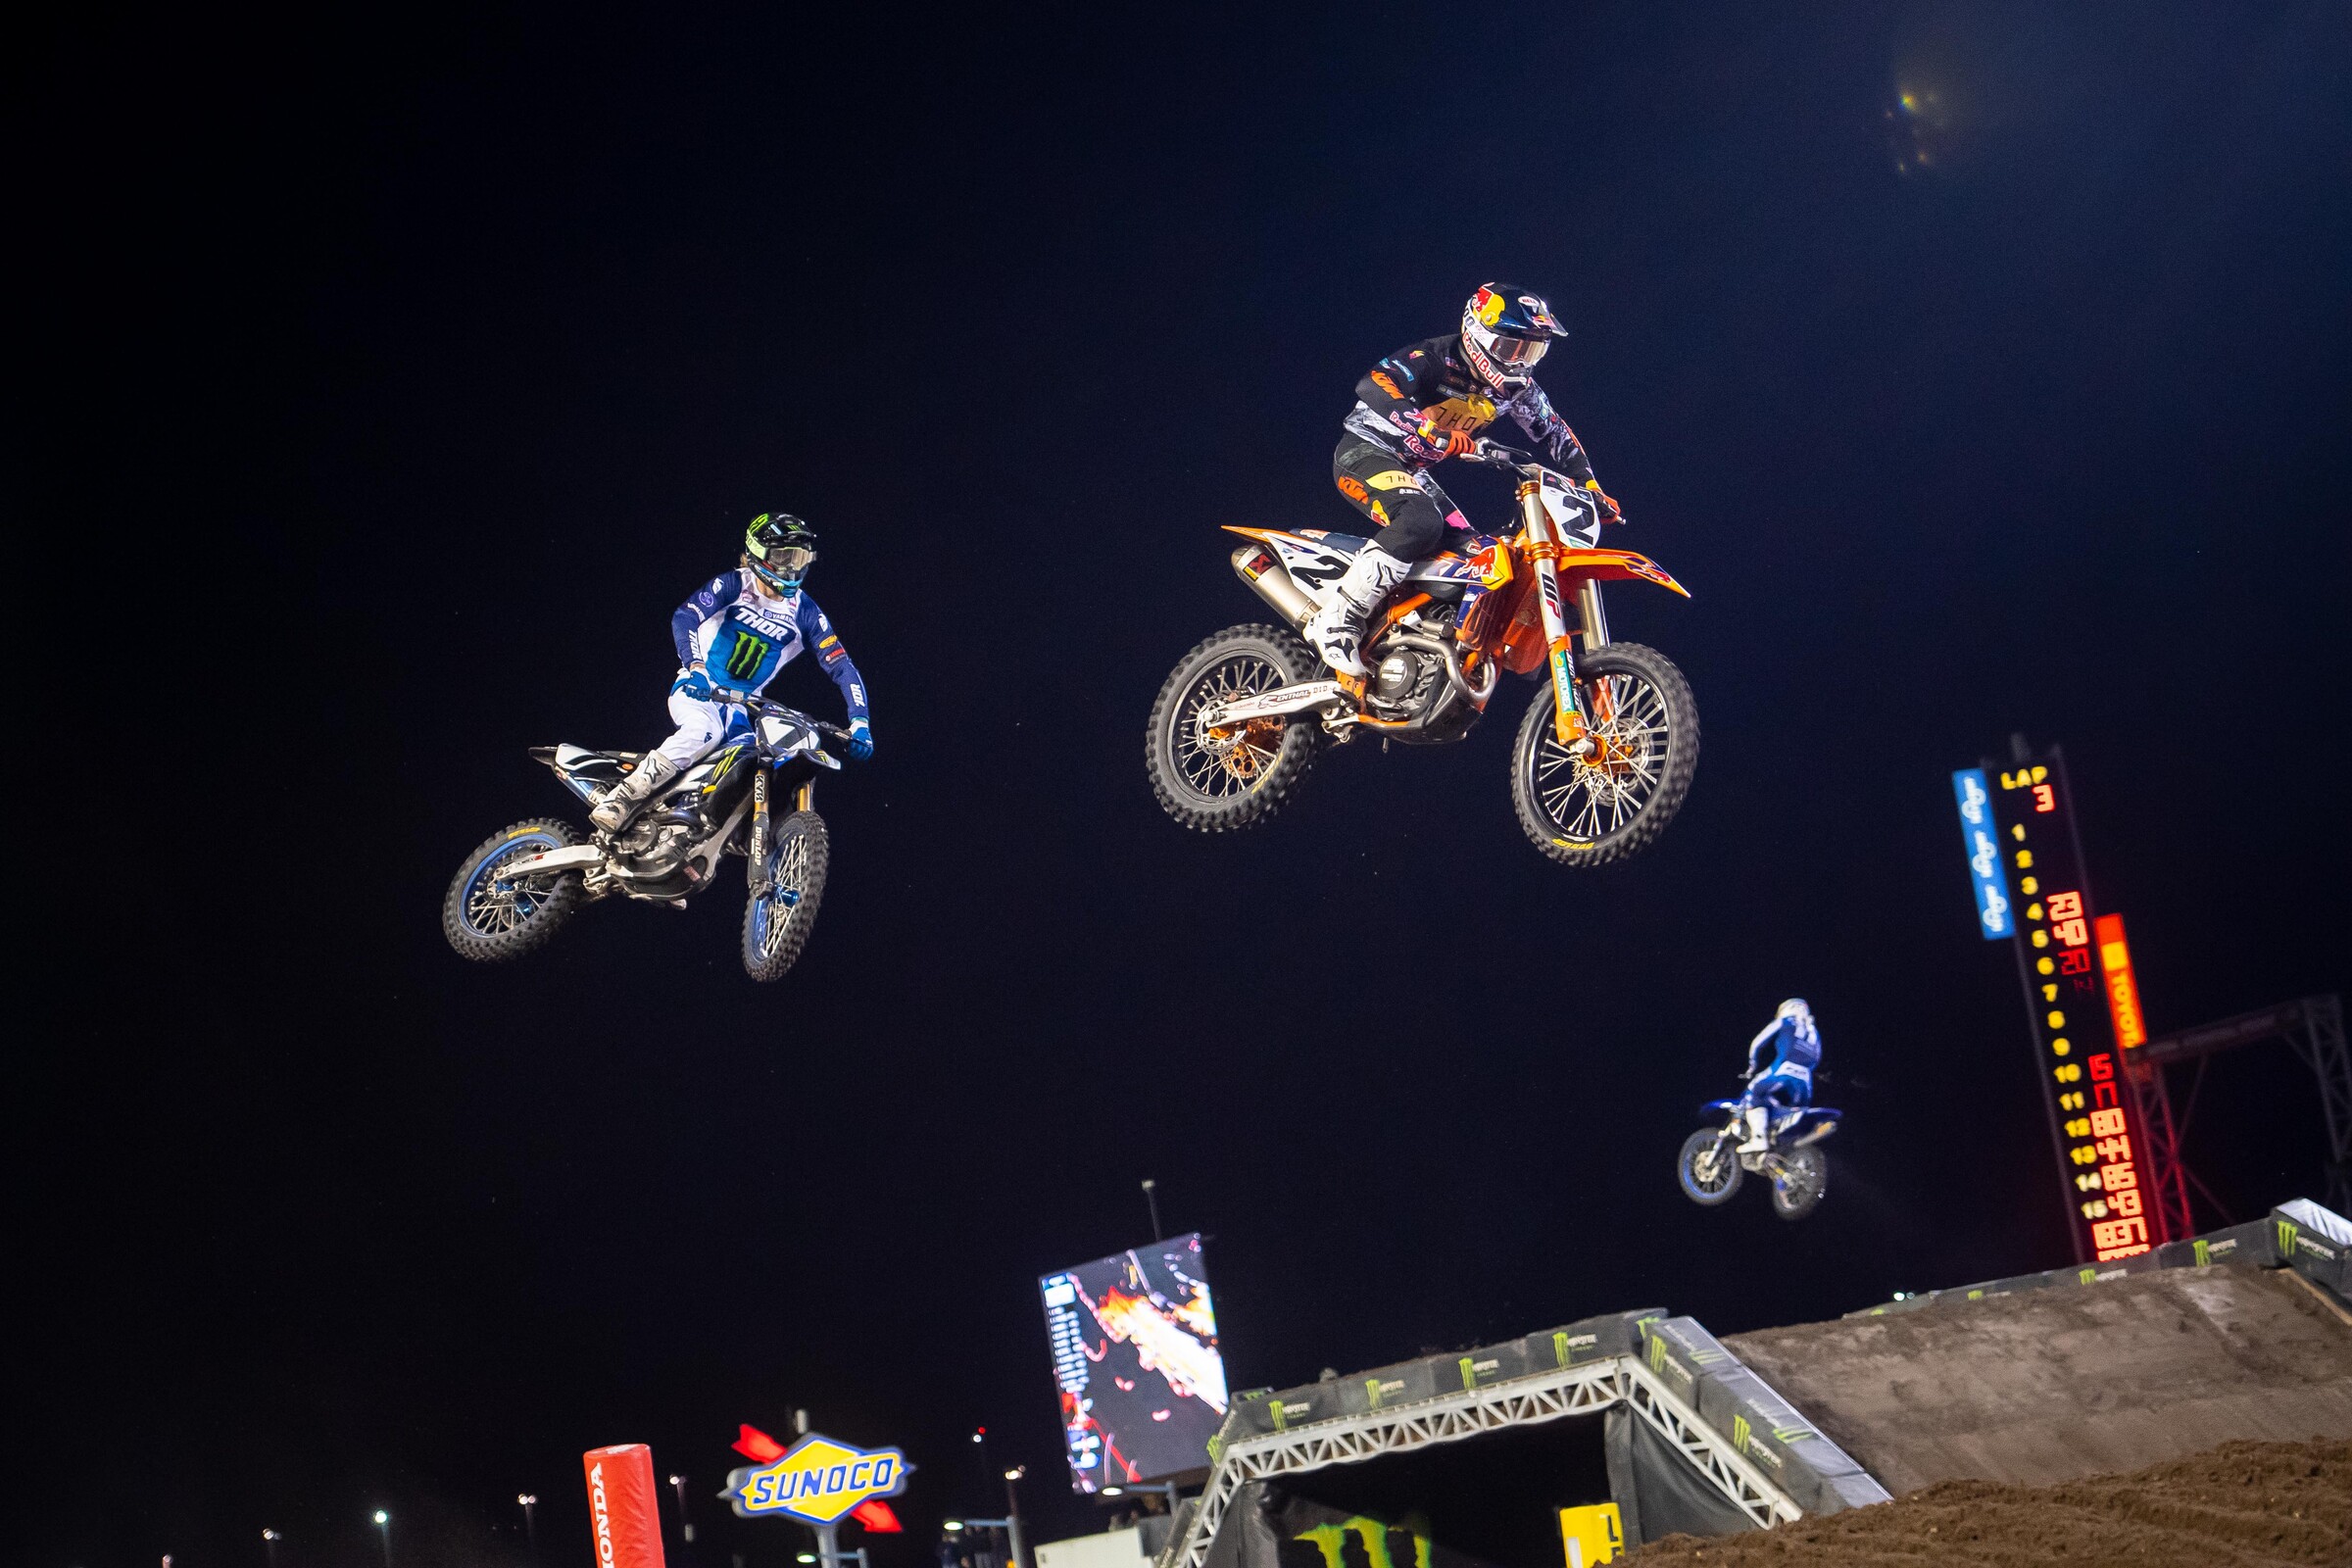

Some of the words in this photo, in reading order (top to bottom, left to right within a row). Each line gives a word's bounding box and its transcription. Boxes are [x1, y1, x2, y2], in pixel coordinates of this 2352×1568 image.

[1478, 359, 1505, 388] Bull
[1561, 494, 1596, 546] 2
[1290, 555, 1351, 591] 2
[735, 607, 788, 642] THOR
[1555, 665, 1572, 711] MOTOREX
[2000, 765, 2048, 790] LAP
[2032, 784, 2054, 812] 3
[754, 825, 762, 866] DUNLOP
[2011, 823, 2026, 842] 1
[2027, 903, 2043, 920] 4
[2041, 983, 2058, 1002] 7
[2059, 1091, 2085, 1110] 11
[2075, 1172, 2103, 1192] 14
[2081, 1200, 2108, 1219] 15
[753, 1457, 895, 1505] SUNOCO
